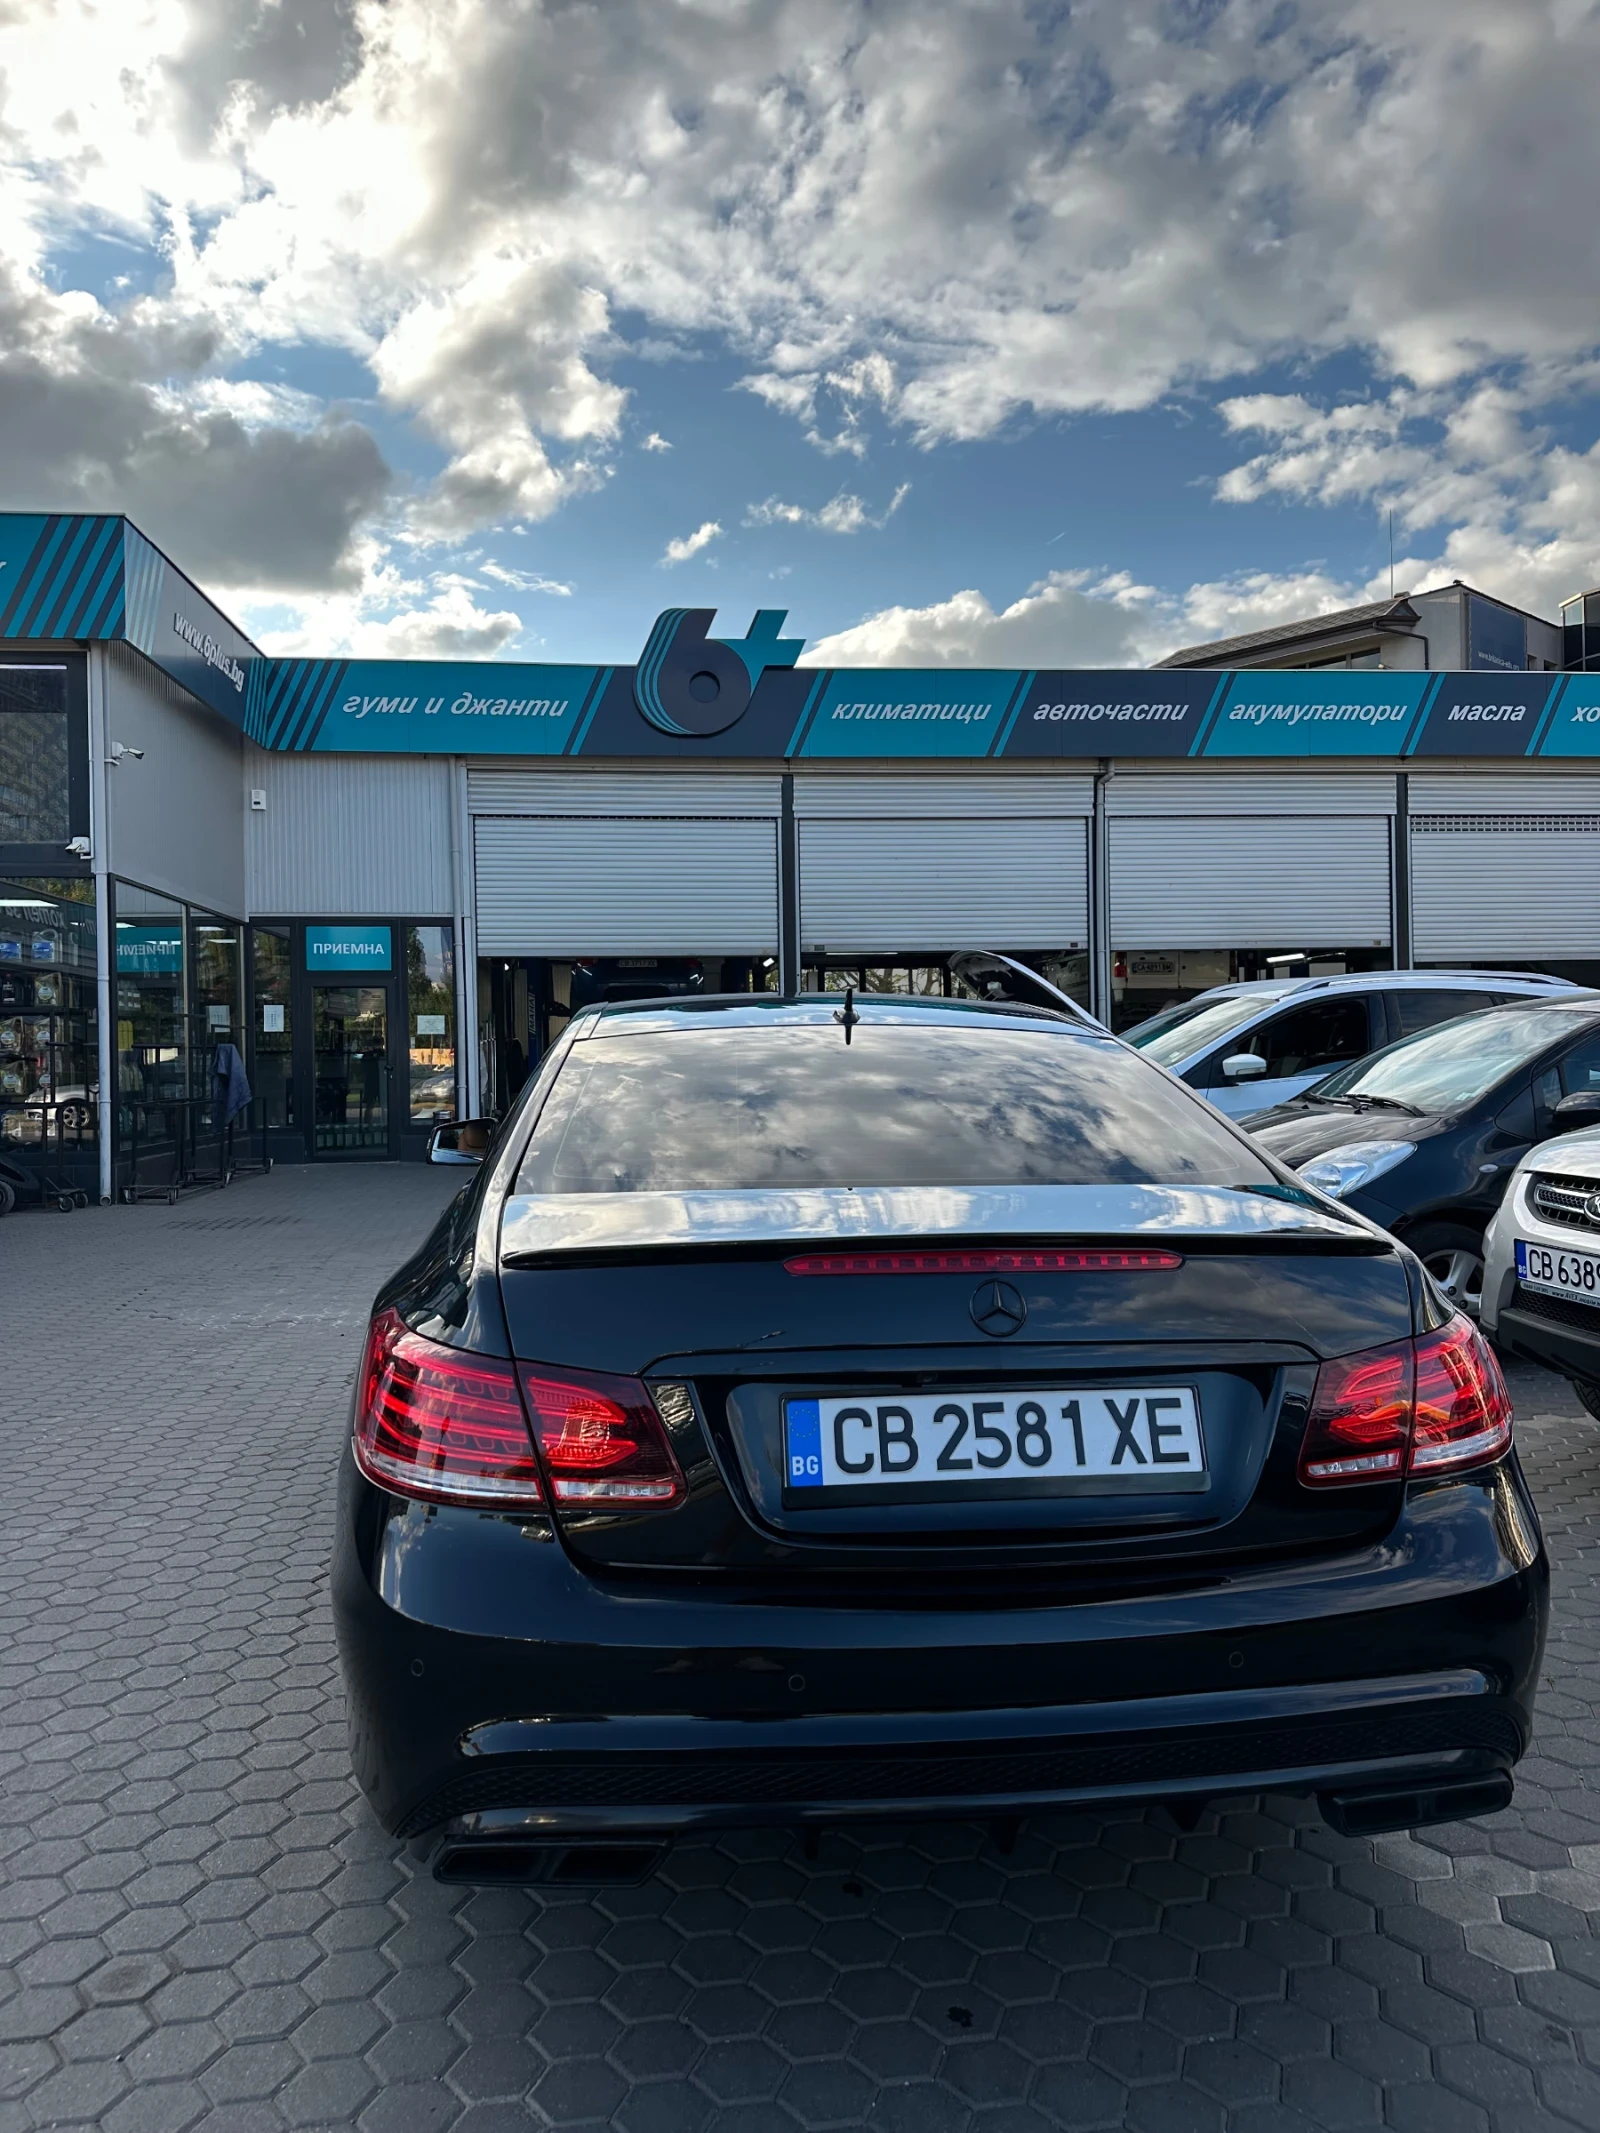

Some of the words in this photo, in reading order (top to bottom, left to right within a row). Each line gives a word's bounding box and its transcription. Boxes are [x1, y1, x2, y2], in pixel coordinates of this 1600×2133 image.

[174, 612, 245, 692] www.6plus.bg
[343, 695, 418, 718] гуми
[425, 697, 445, 714] и
[451, 691, 569, 717] джанти
[831, 702, 992, 723] климатици
[1033, 702, 1189, 722] авточасти
[1229, 701, 1408, 726] акумулатори
[1448, 703, 1526, 721] масла
[313, 943, 385, 955] ПРИЕМНА
[1518, 1264, 1527, 1275] BG
[1529, 1249, 1553, 1280] CB
[833, 1406, 919, 1474] CB
[933, 1400, 1086, 1470] 2581
[1103, 1398, 1190, 1465] XE
[792, 1456, 819, 1476] BG
